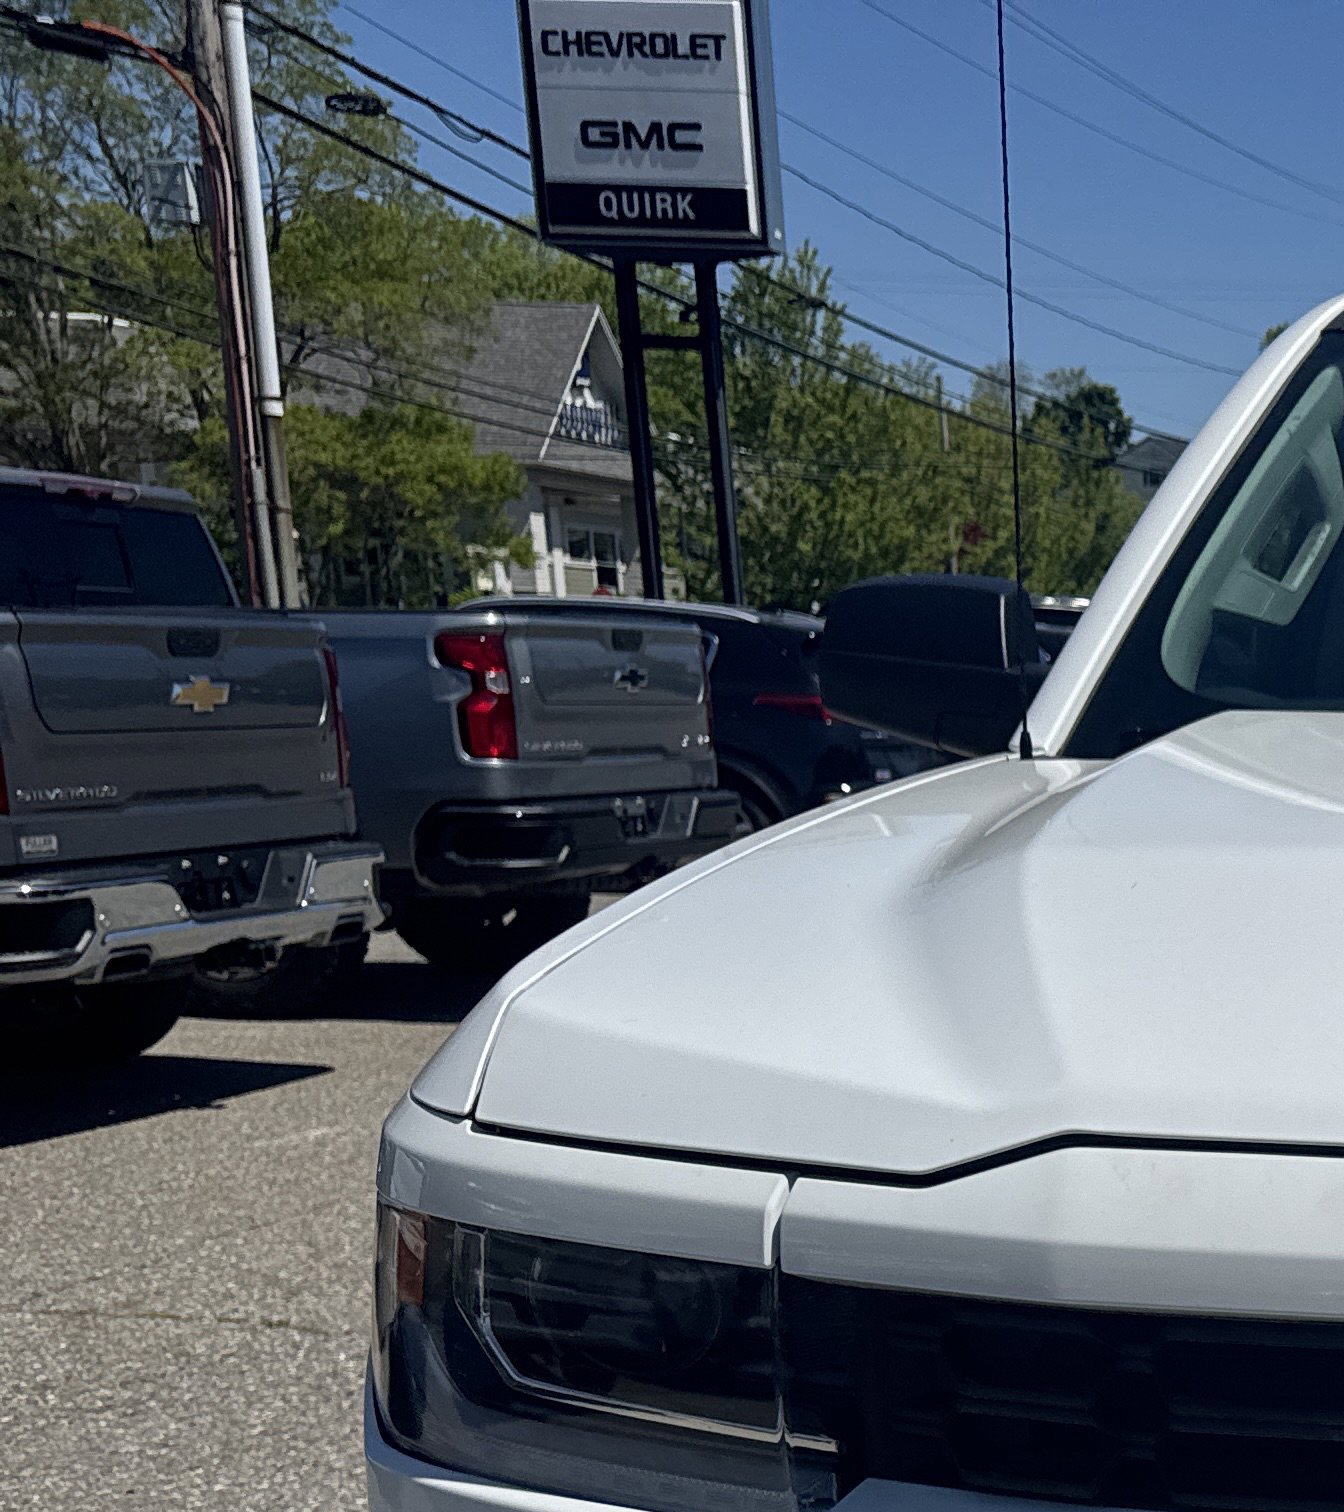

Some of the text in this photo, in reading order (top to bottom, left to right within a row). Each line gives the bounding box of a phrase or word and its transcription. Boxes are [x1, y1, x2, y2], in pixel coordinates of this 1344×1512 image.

[540, 30, 727, 61] CHEVROLET
[579, 120, 704, 152] GMC
[599, 190, 696, 220] QUIRK
